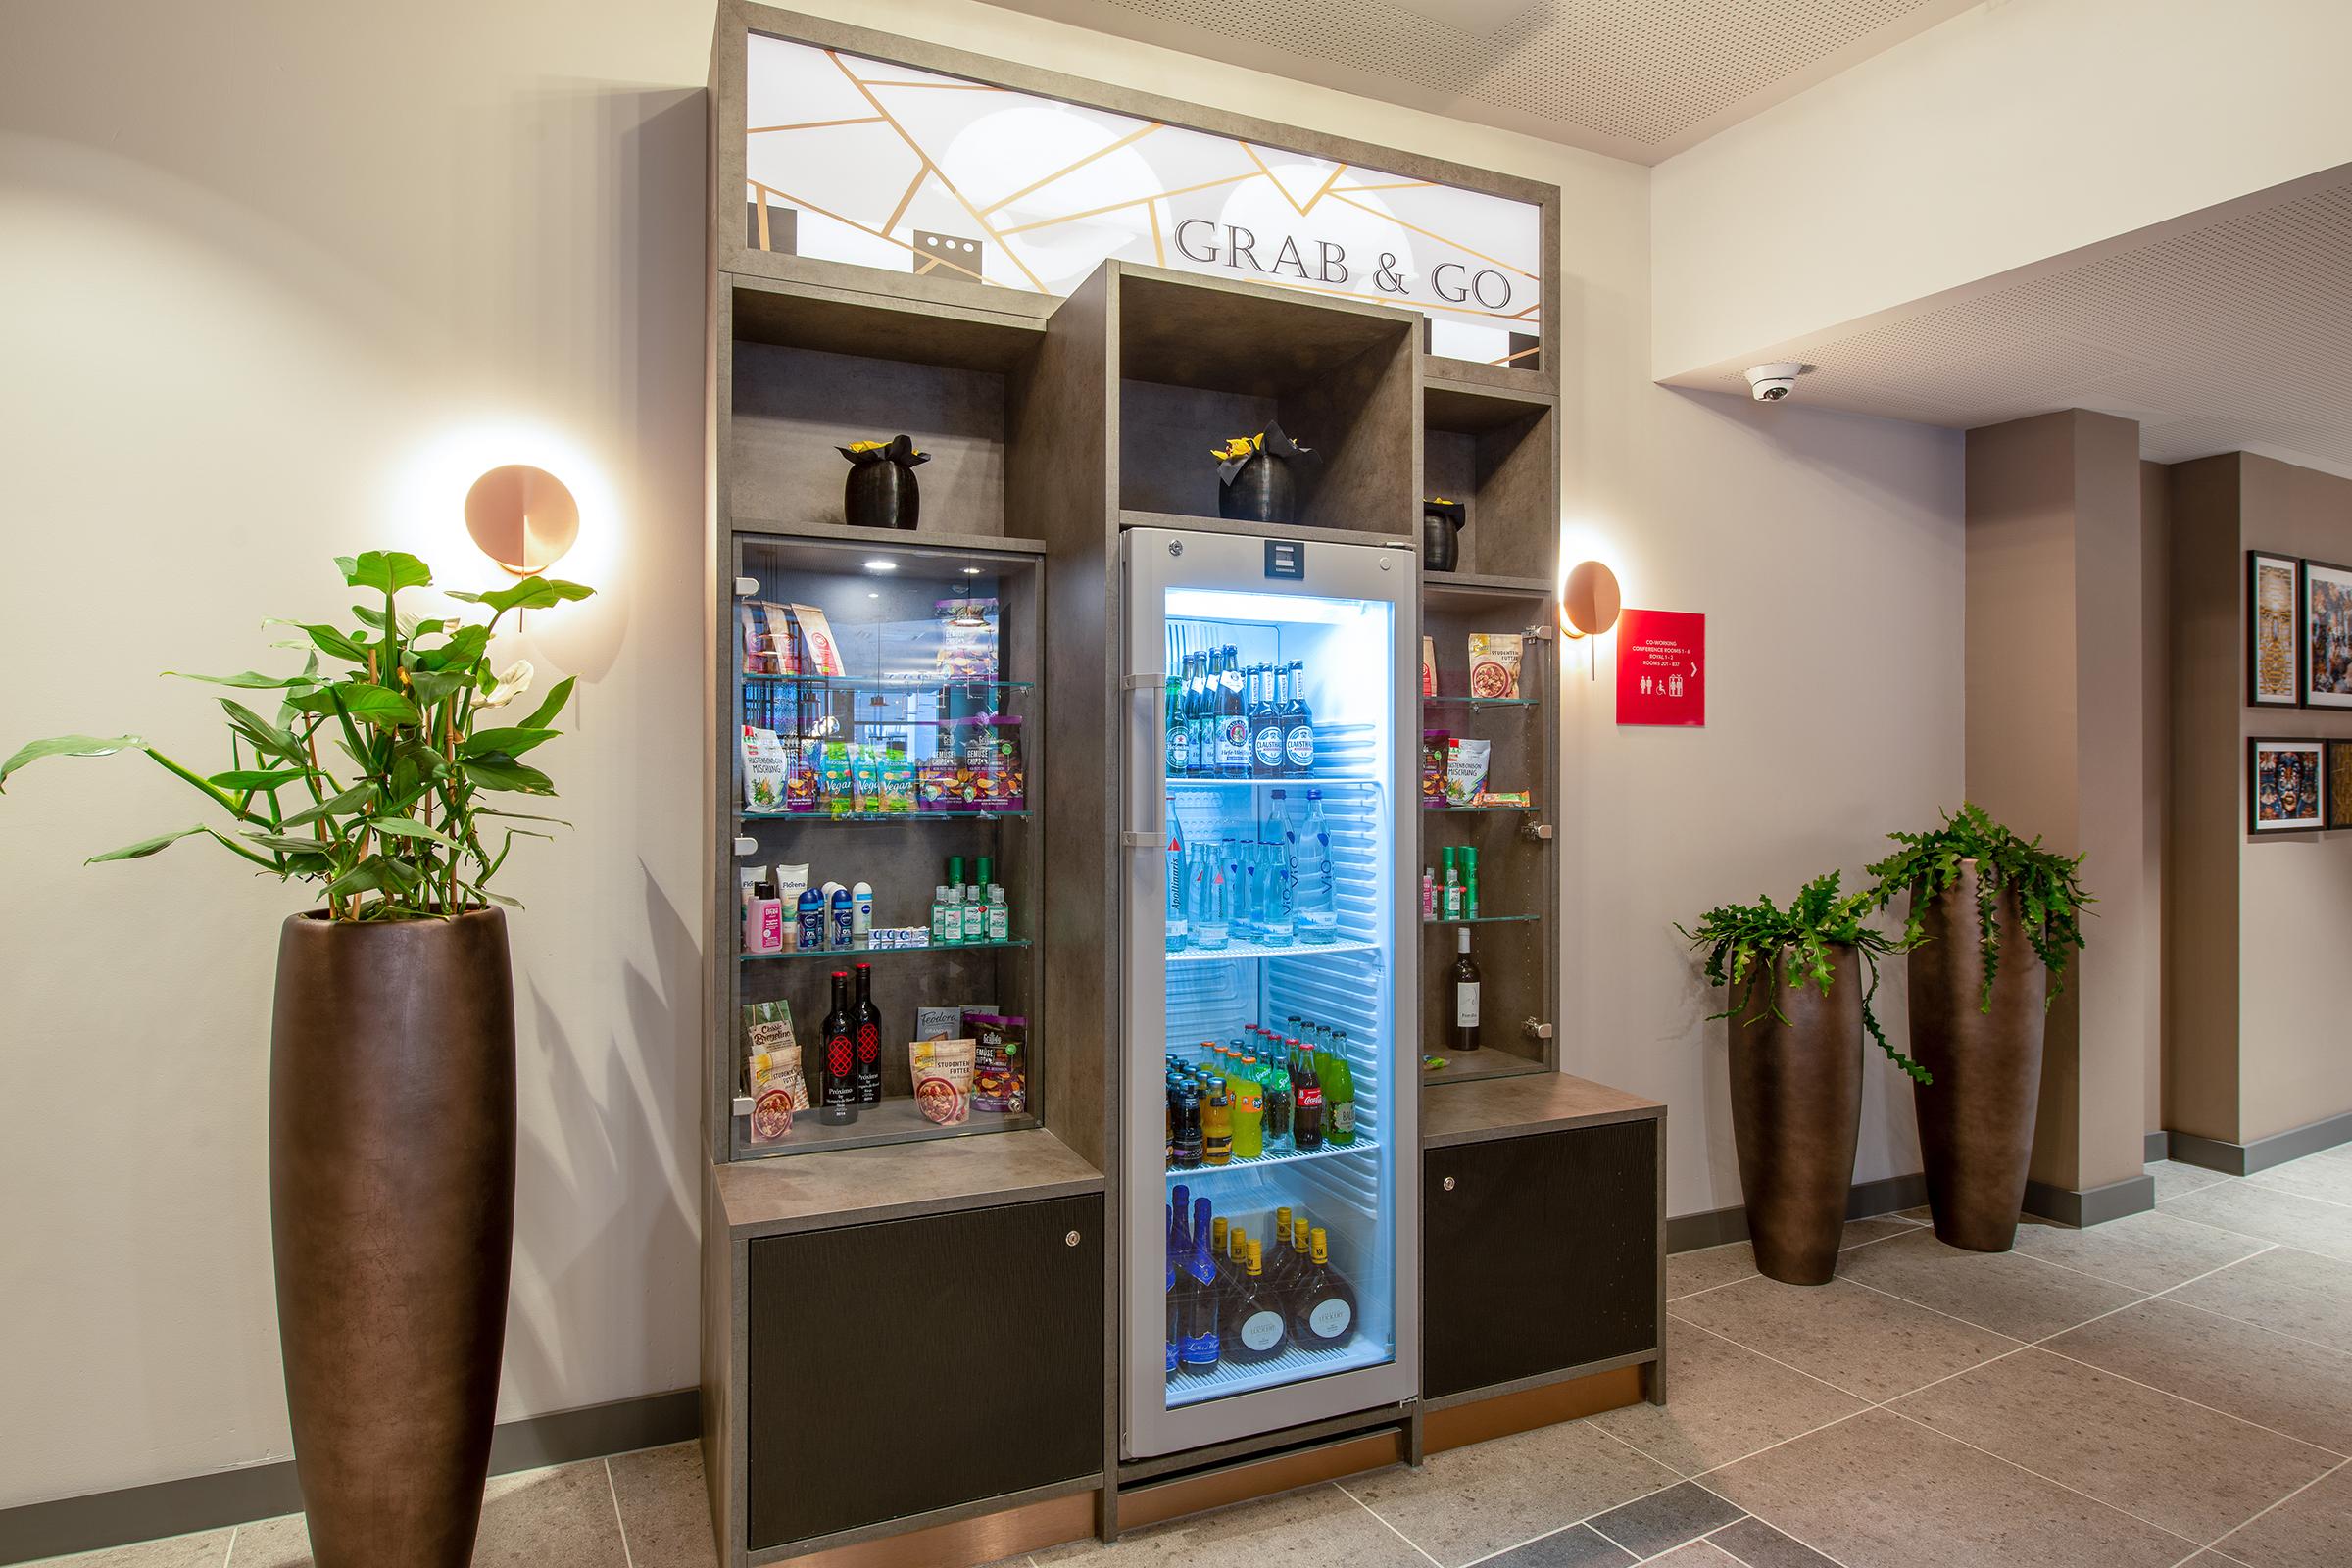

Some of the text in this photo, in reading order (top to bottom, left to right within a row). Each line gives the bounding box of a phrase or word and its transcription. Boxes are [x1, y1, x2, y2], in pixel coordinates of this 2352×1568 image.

[1174, 218, 1512, 309] GRAB & GO
[883, 780, 911, 795] Vegan
[1171, 858, 1180, 910] Apollinaris
[1290, 856, 1298, 888] ViO
[1320, 860, 1332, 895] ViO
[1282, 889, 1292, 915] ViO
[921, 1010, 957, 1027] Feodora
[976, 1047, 994, 1058] EMÜSE
